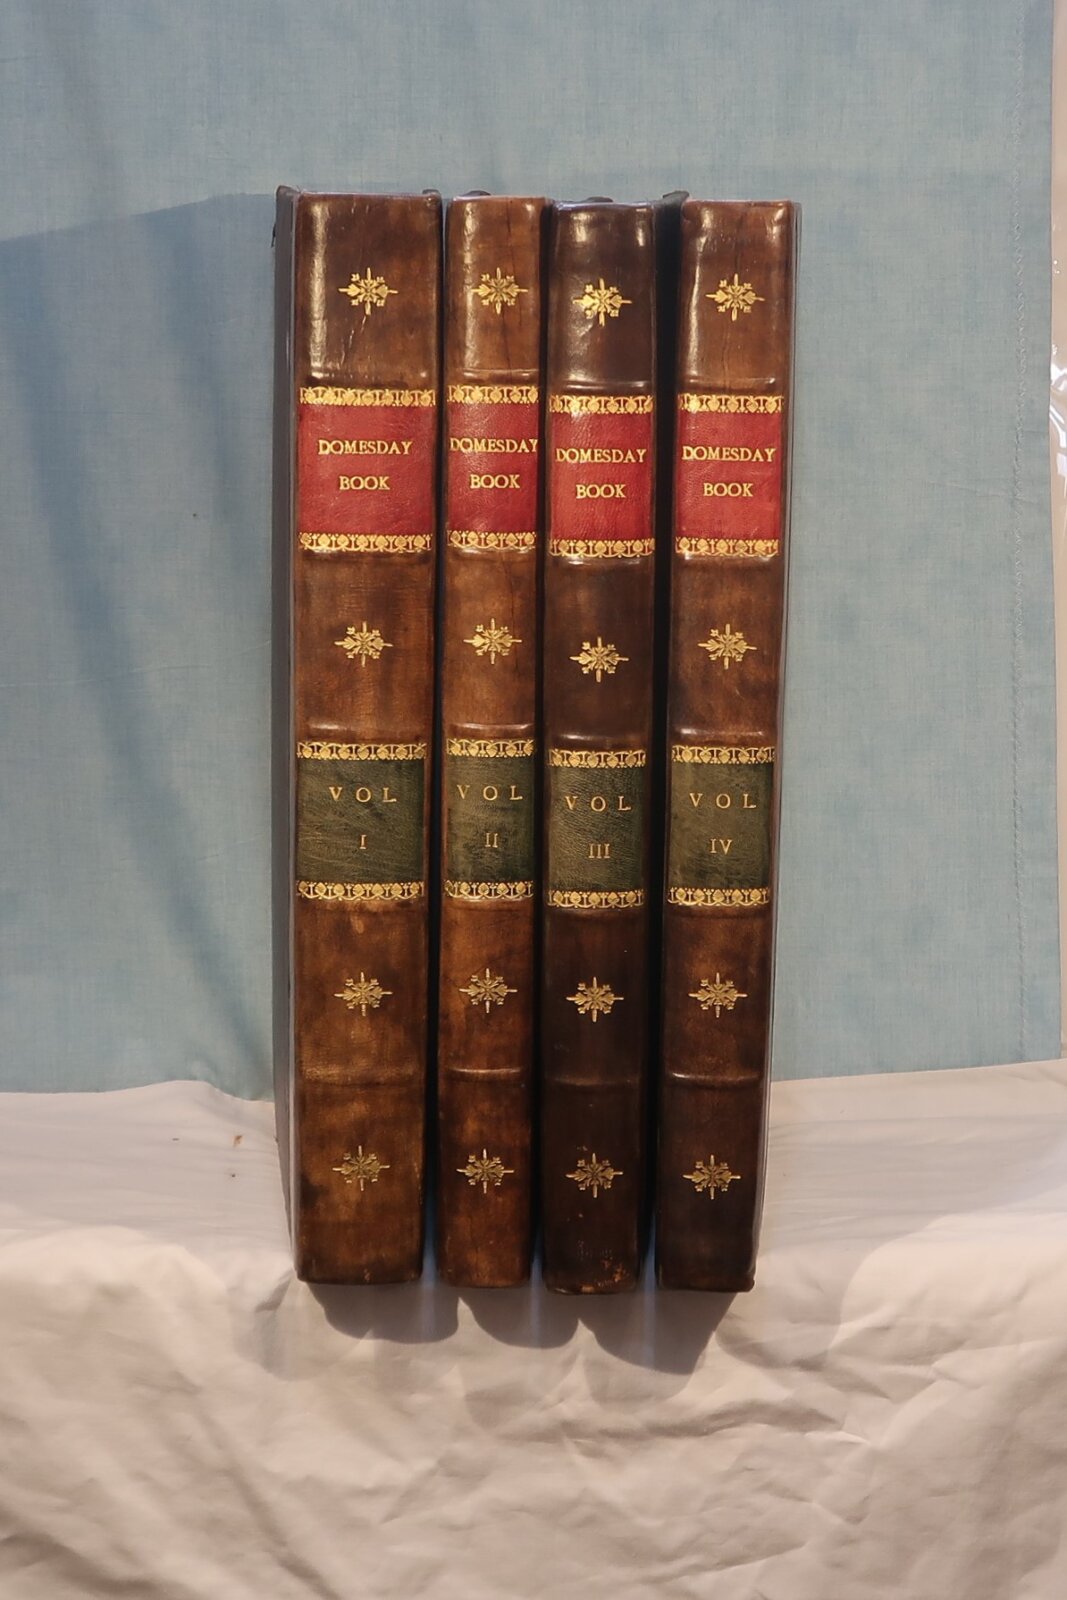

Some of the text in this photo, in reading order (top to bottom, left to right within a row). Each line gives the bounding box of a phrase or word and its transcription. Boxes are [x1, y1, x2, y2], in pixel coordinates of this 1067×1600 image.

[318, 440, 412, 455] DOMESDAY
[450, 437, 538, 453] DOMESDAY
[556, 448, 646, 463] DOMESDAY
[682, 446, 776, 462] DOMESDAY
[339, 475, 390, 491] BOOK
[470, 473, 520, 490] BOOK
[576, 483, 626, 499] BOOK
[703, 482, 754, 498] BOOK
[329, 787, 397, 803] VOL
[457, 785, 523, 801] VOL
[690, 793, 756, 809] VOL
[565, 795, 631, 812] VOL
[359, 834, 367, 850] I
[485, 833, 498, 848] II
[709, 838, 733, 854] IV
[588, 842, 611, 859] III
